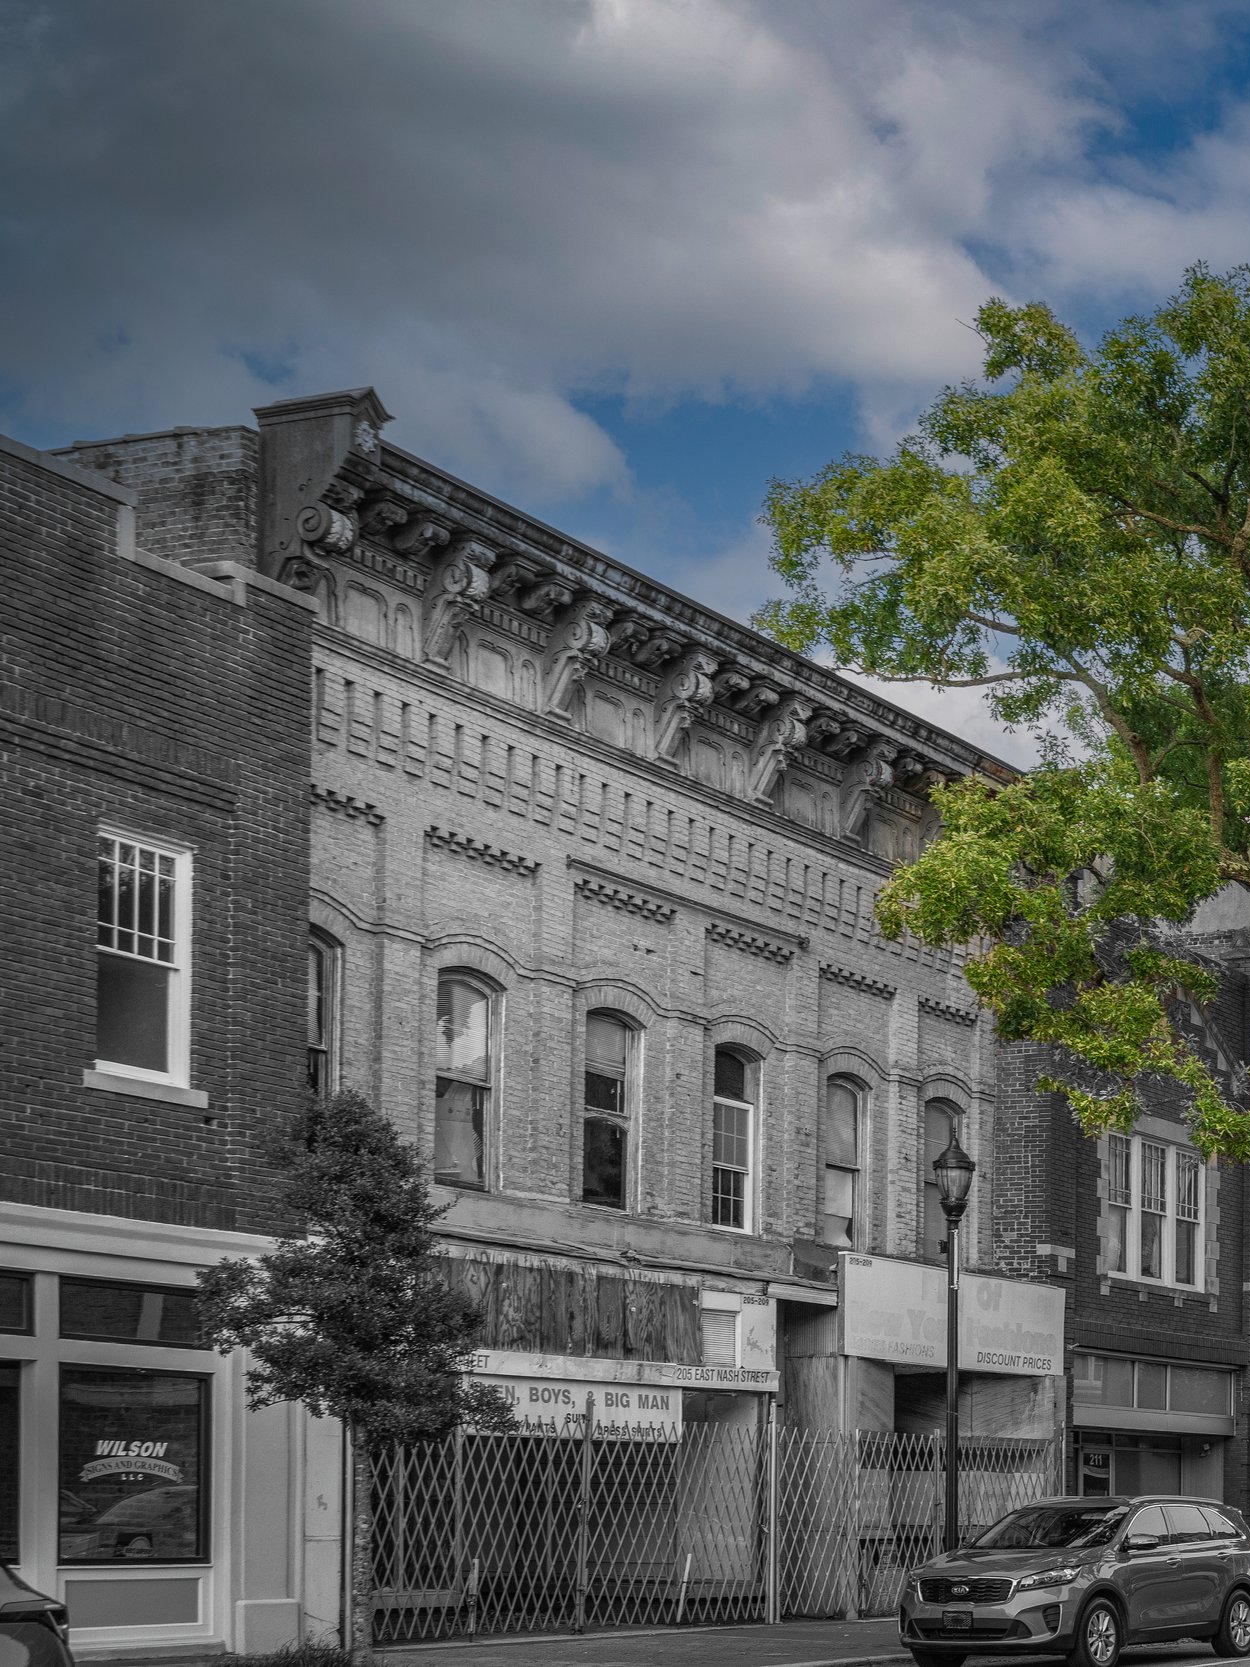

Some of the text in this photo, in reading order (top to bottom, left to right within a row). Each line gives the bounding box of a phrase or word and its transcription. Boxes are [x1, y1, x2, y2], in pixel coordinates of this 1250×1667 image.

[849, 1257, 872, 1267] 205-209
[743, 1297, 769, 1307] 205-209
[888, 1341, 935, 1358] FASHIONS
[977, 1352, 1052, 1371] DISCOUNT PRICES
[677, 1368, 770, 1384] 205 EAST NASH STREET
[529, 1387, 575, 1408] BOYS,
[604, 1392, 630, 1408] BIG
[638, 1394, 669, 1410] MAN
[598, 1426, 626, 1436] DRESS
[632, 1427, 662, 1438] SHIRTS
[96, 1440, 168, 1457] WILSON
[1090, 1454, 1103, 1466] 211
[86, 1460, 179, 1477] SIGNS AND GRAPHICS
